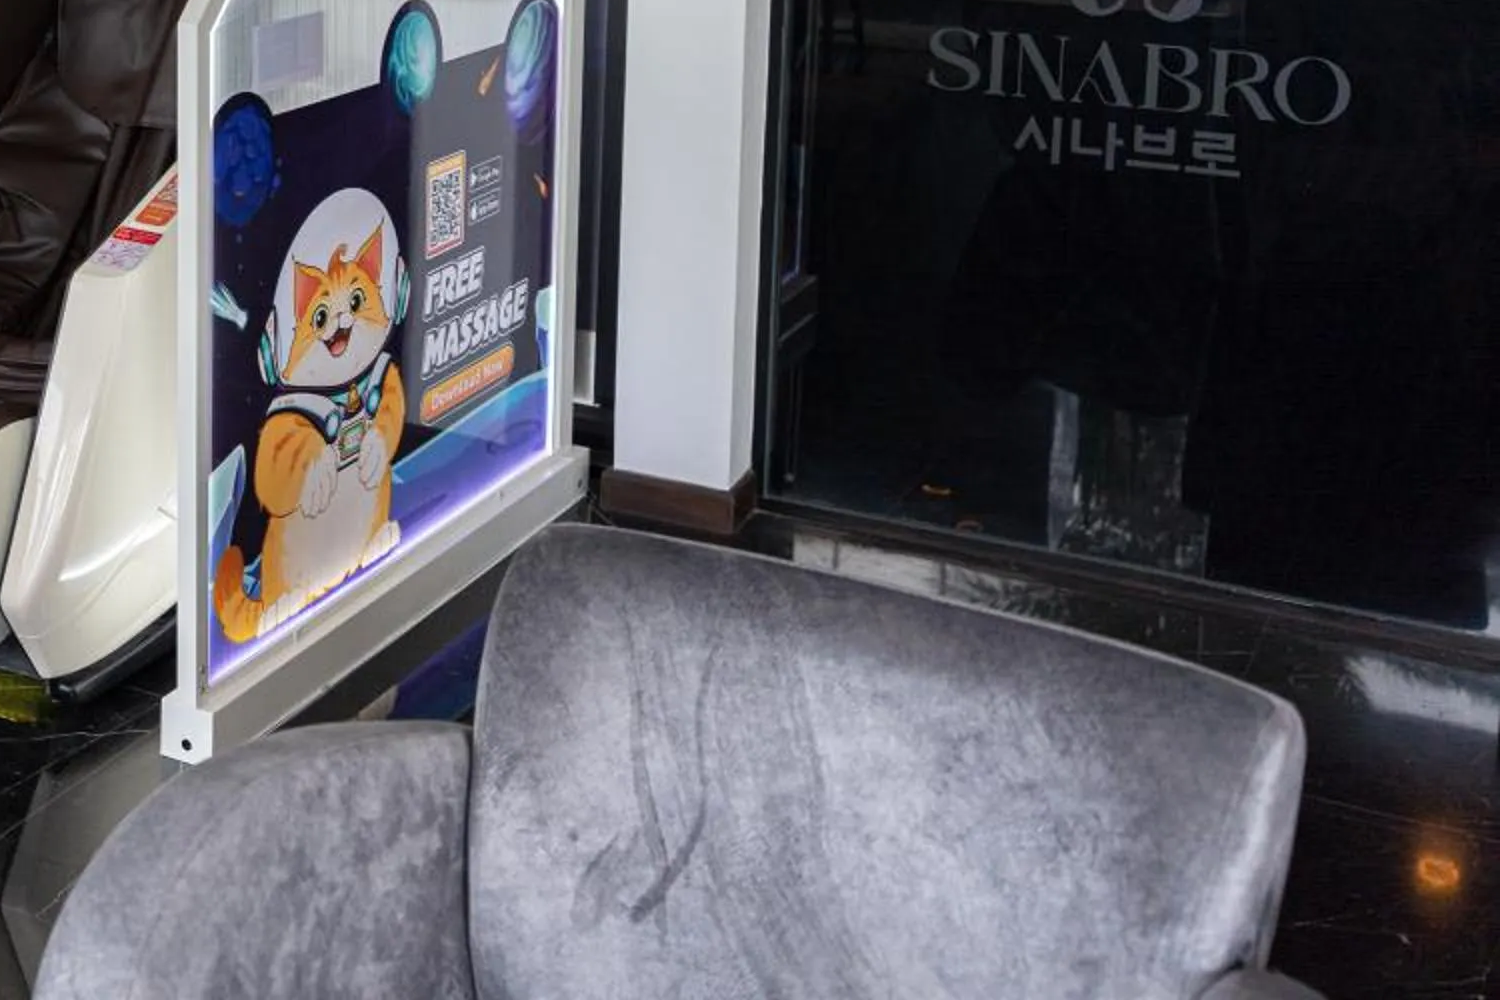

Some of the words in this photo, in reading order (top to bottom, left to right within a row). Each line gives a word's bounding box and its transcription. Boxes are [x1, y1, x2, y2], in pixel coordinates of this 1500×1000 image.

[927, 27, 1352, 126] SINABRO
[1013, 114, 1241, 179] 시나브로
[423, 247, 485, 320] FREE
[421, 280, 529, 379] MASSAGE
